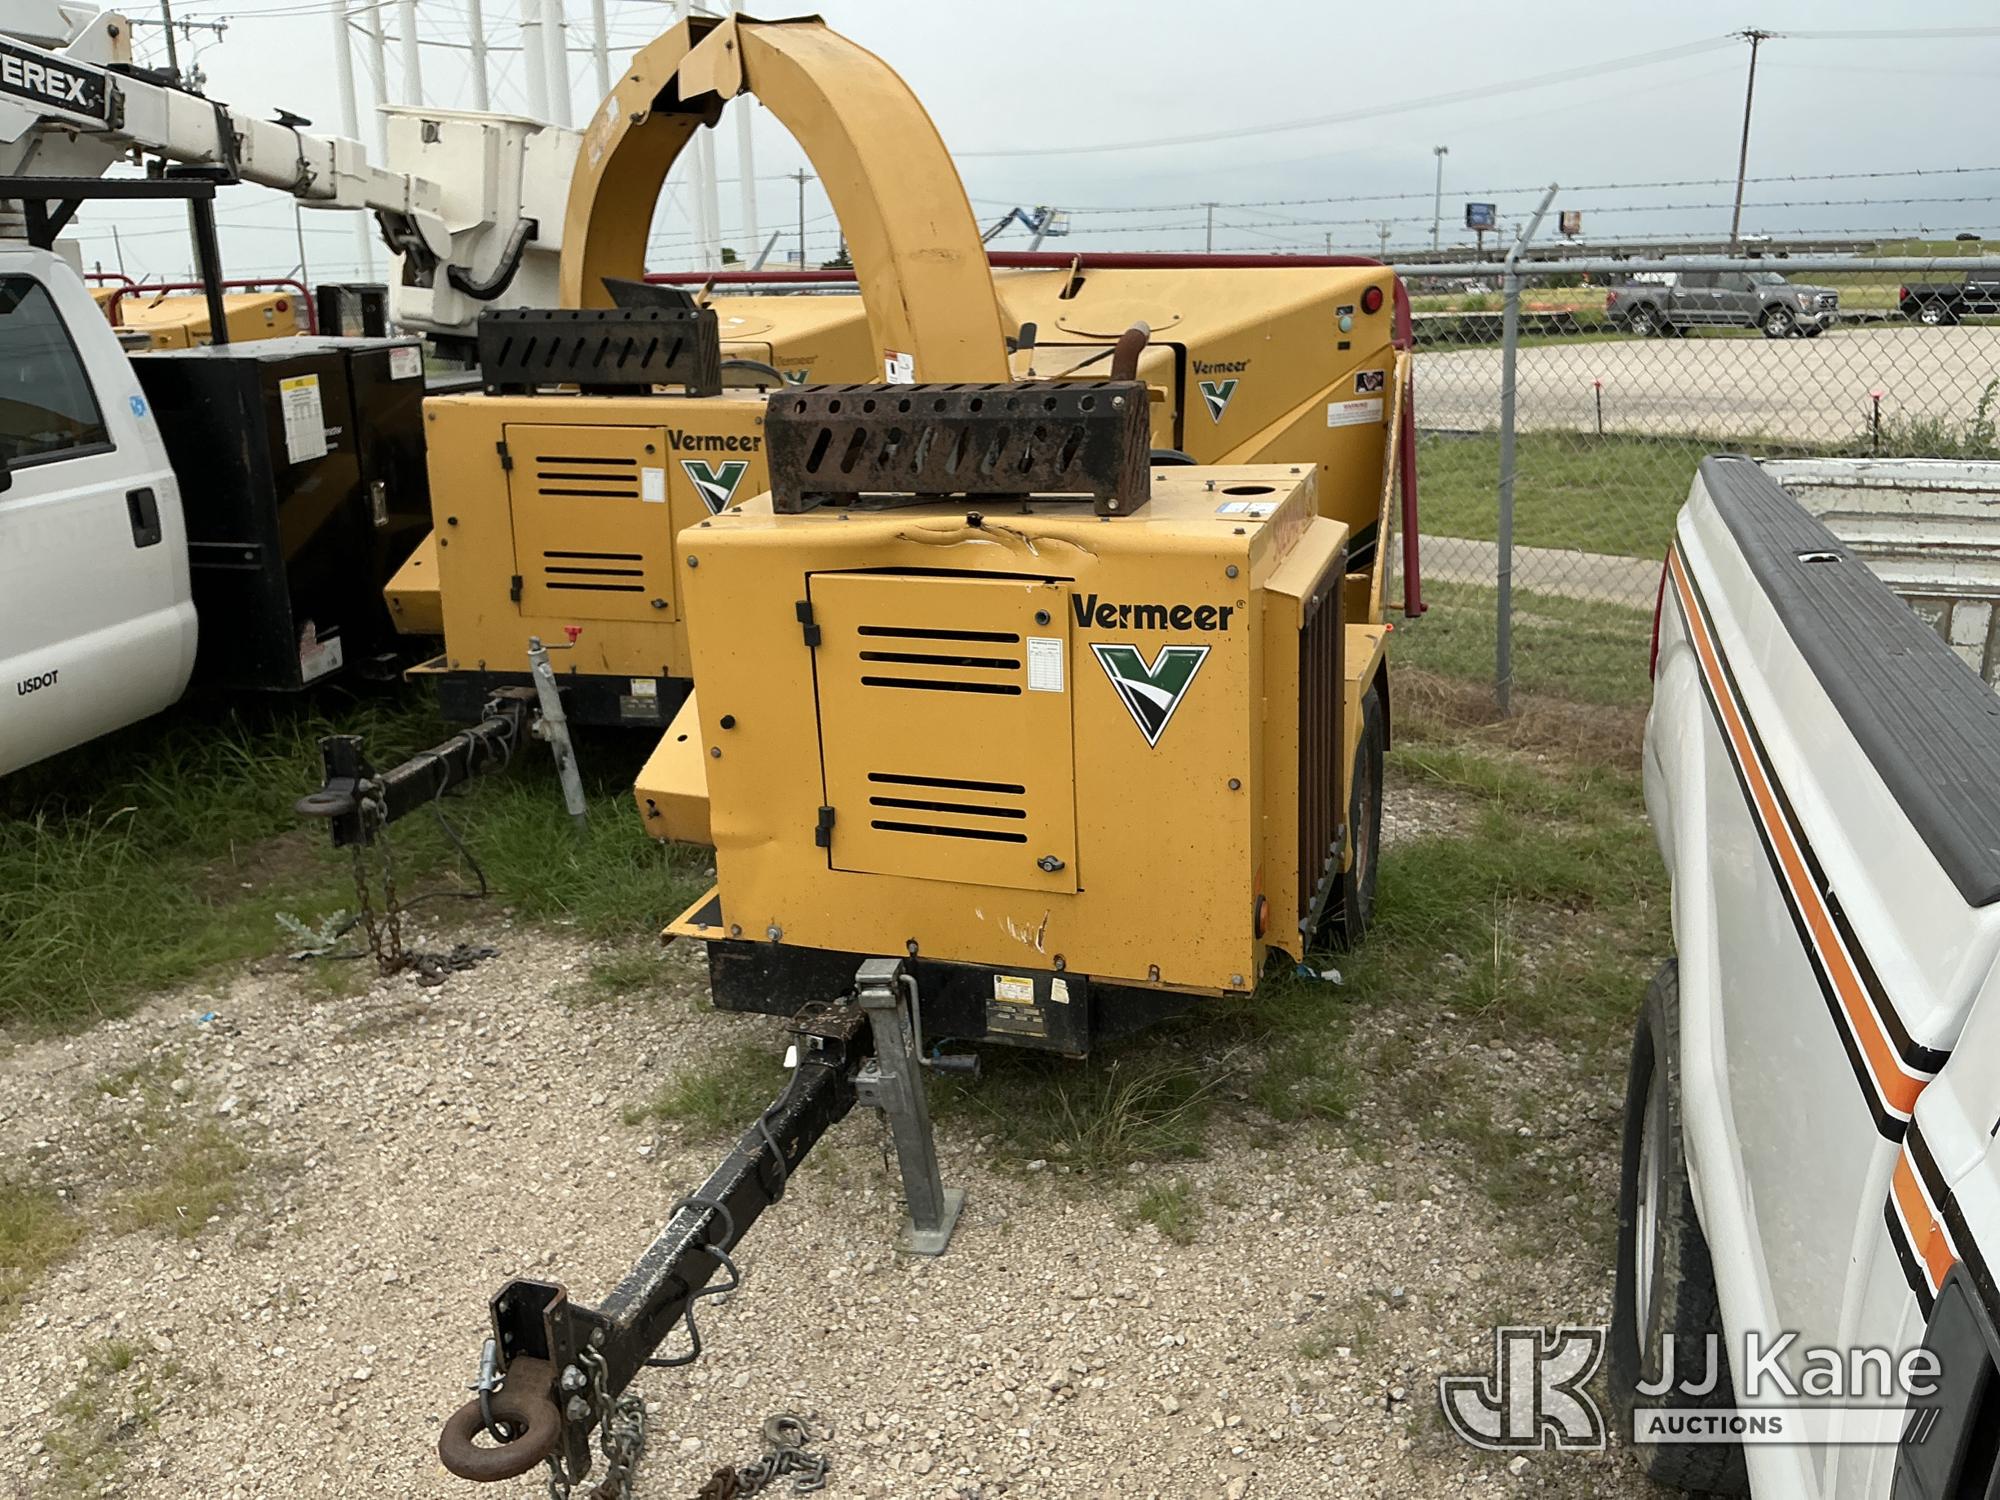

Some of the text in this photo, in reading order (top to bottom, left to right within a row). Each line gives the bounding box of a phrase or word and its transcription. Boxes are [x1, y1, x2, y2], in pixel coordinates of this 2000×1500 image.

[0, 52, 87, 107] EREX
[1192, 360, 1247, 375] Vermeer
[667, 429, 762, 452] Vermeer
[1071, 593, 1234, 631] Vermeer
[17, 669, 59, 696] USDOT
